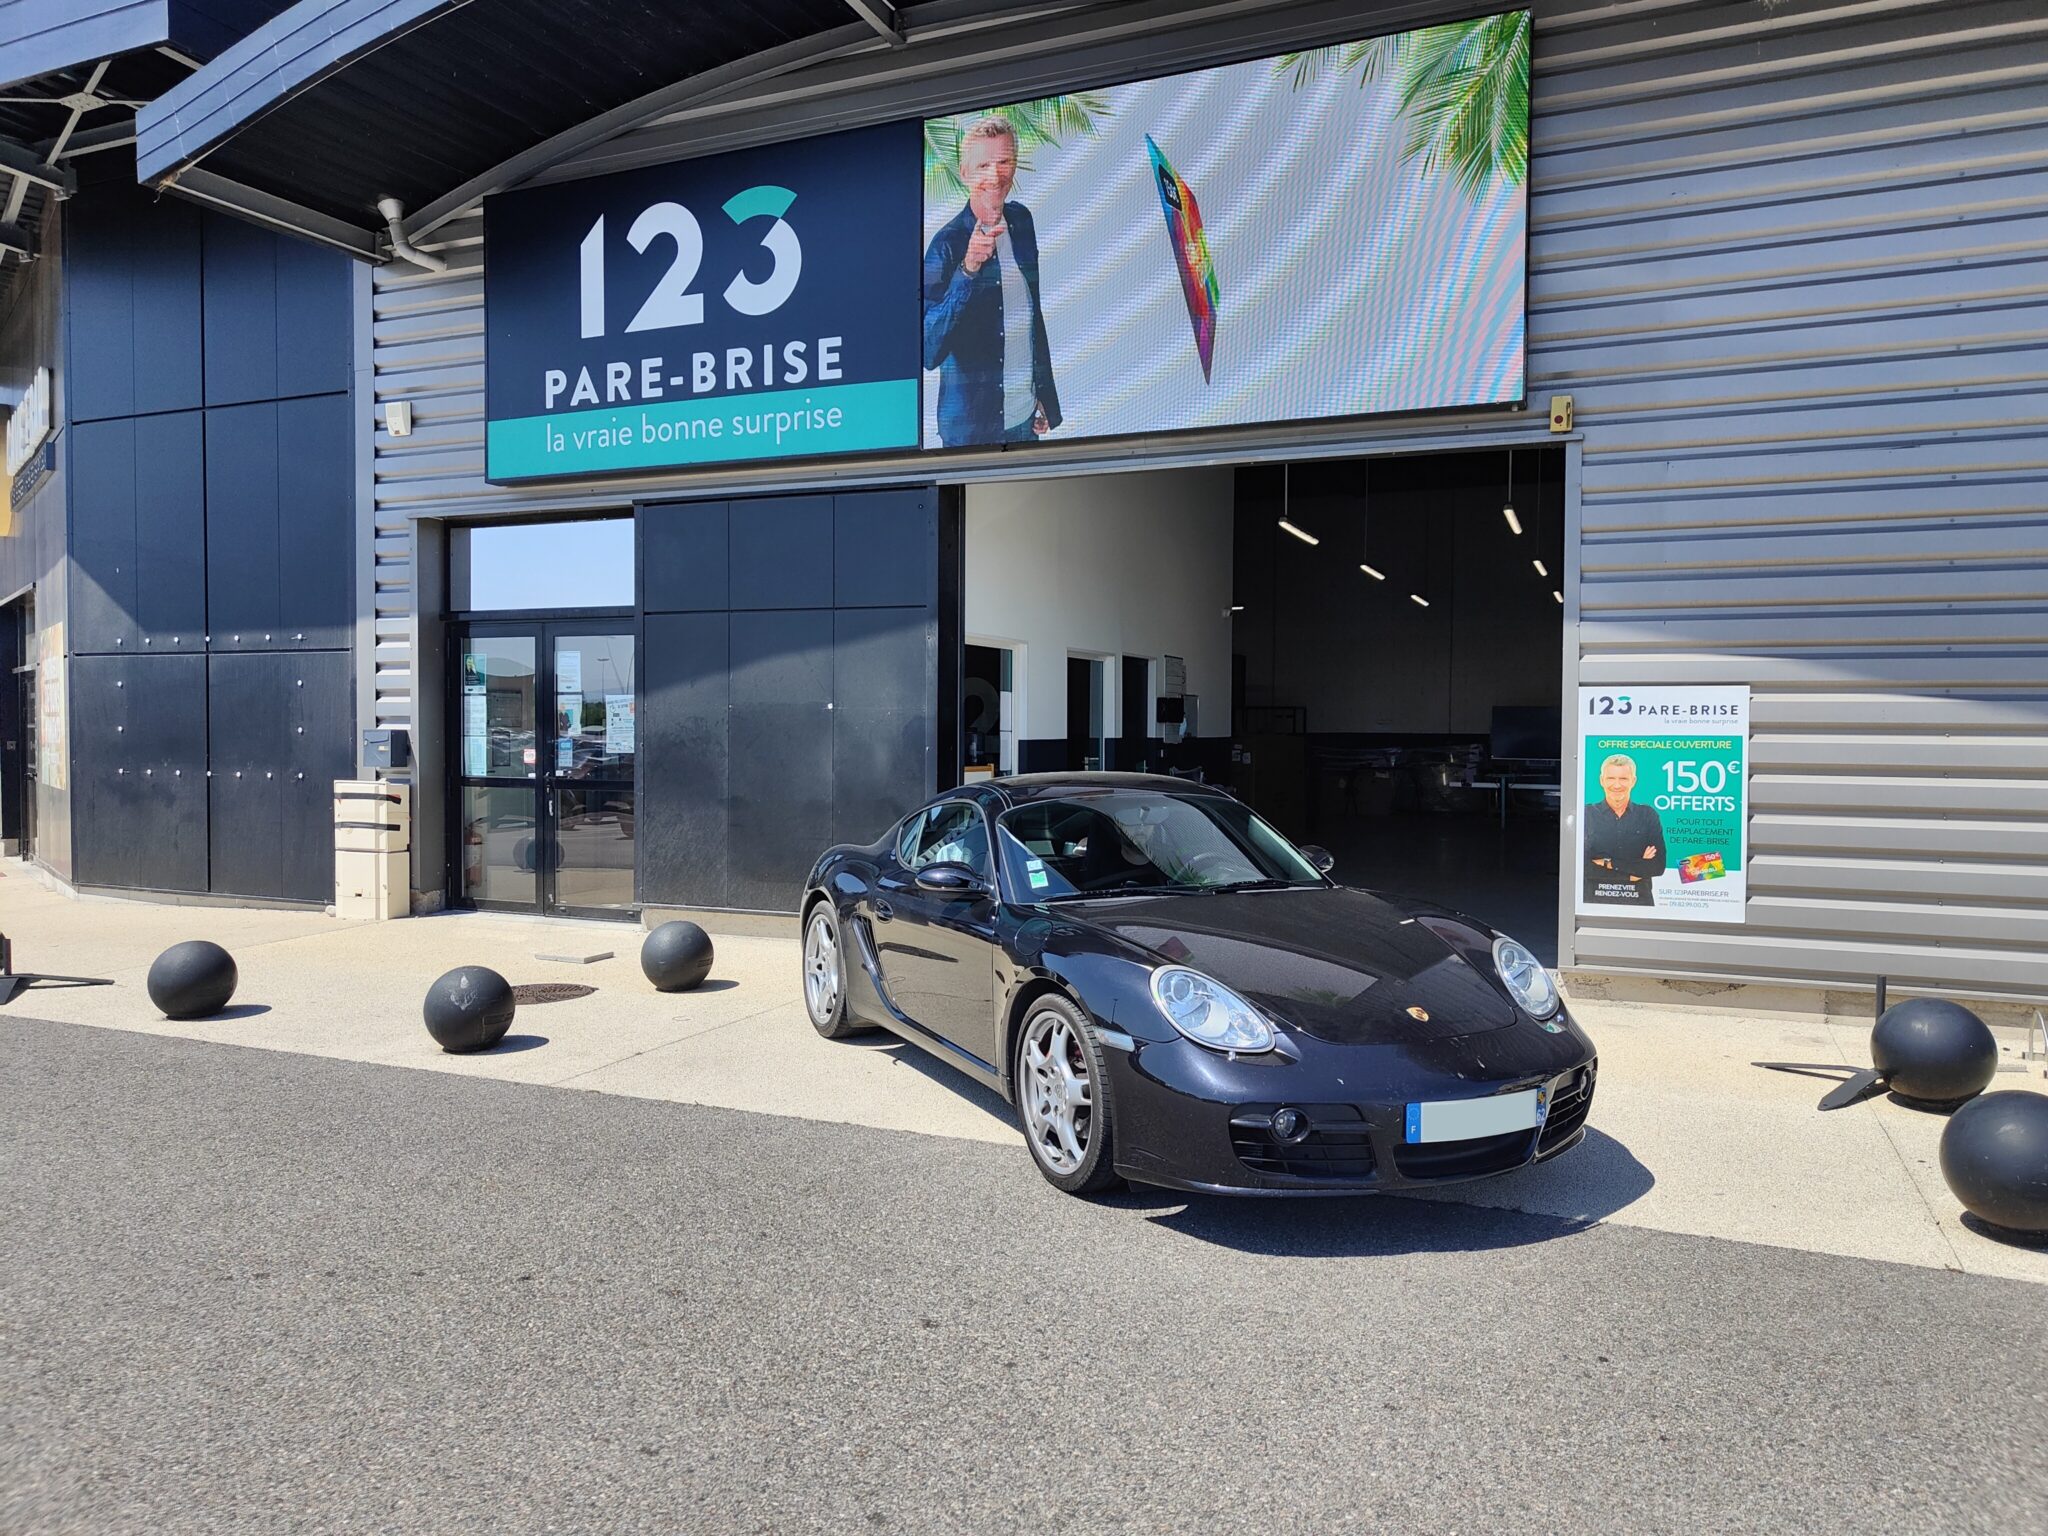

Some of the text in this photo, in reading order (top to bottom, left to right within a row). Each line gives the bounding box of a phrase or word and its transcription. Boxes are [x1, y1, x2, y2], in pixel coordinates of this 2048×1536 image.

[580, 185, 802, 339] 123
[545, 336, 843, 410] PARE-BRISE
[546, 397, 843, 453] la vraie bonne surprise
[1589, 695, 1739, 716] 123 PARE-BRISE
[1689, 717, 1710, 725] bonne
[1711, 718, 1739, 726] surprise
[1598, 740, 1732, 749] OFFRE SPECIALE OUVERTURE
[1661, 760, 1741, 794] 150€
[1653, 794, 1736, 812] OFFERTS
[1676, 817, 1723, 827] POUR TOUT
[1666, 827, 1734, 836] REMPLACEMENT
[1669, 836, 1729, 846] DE PARE-BRISE
[1598, 883, 1622, 891] PRENEZ
[1658, 888, 1673, 896] SUR
[1594, 889, 1640, 899] RENDEZ-VOUS
[1536, 1108, 1546, 1122] 62
[1411, 1125, 1416, 1134] F
